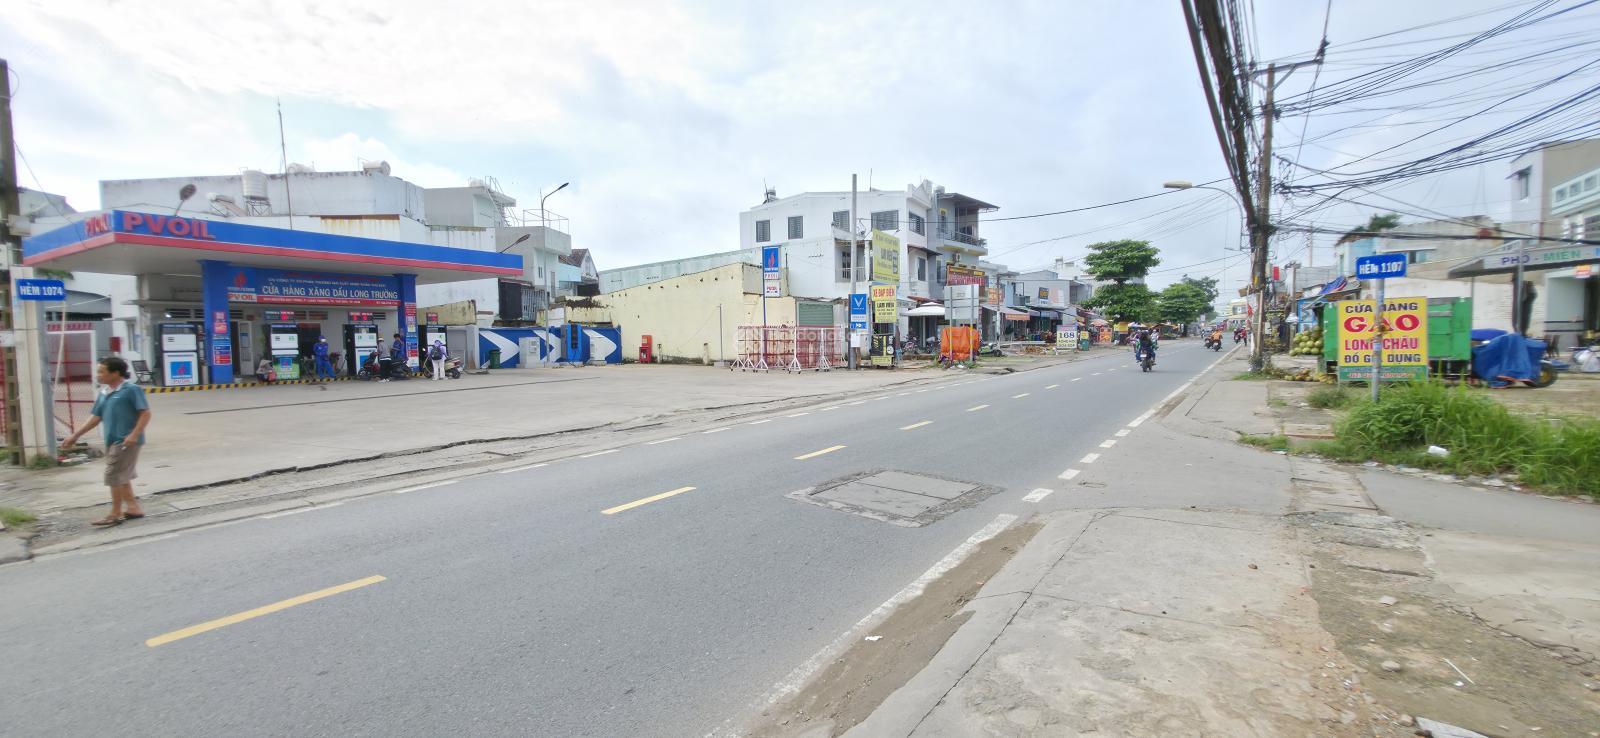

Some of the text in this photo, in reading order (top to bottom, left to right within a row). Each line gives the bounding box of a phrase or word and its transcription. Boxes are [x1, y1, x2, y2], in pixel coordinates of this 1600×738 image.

[123, 211, 216, 240] PVOIL
[1381, 261, 1403, 273] 1107
[42, 286, 63, 296] 1074
[283, 285, 306, 297] HÀNG
[350, 288, 369, 299] LONG
